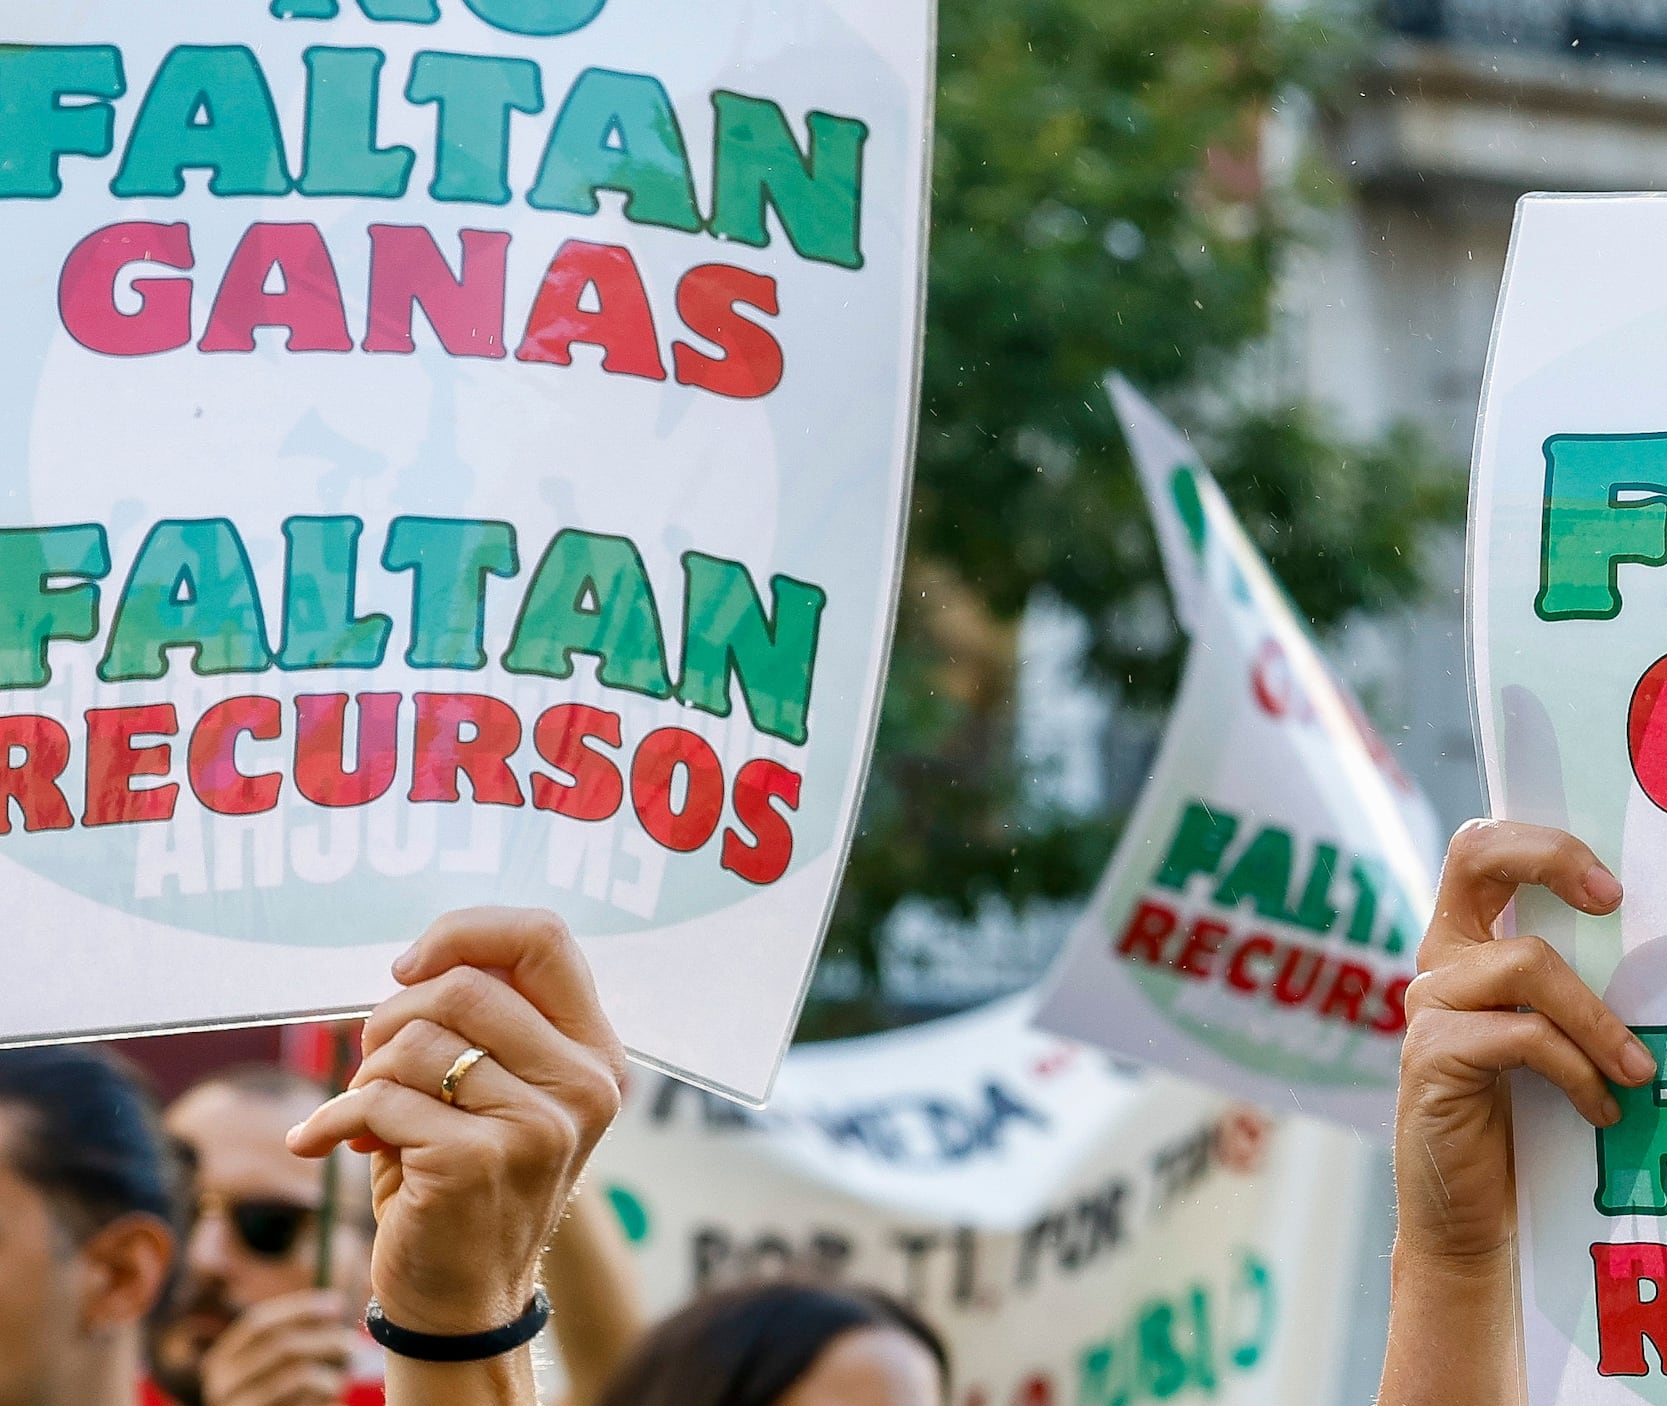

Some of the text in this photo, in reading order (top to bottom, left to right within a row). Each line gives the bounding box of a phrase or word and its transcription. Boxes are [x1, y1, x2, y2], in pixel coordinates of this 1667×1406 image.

[0, 44, 867, 271] FALTAN
[58, 221, 785, 399] GANAS
[0, 514, 827, 746] FALTAN
[0, 692, 803, 886] RECURSOS
[1115, 894, 1407, 1036] RECURS
